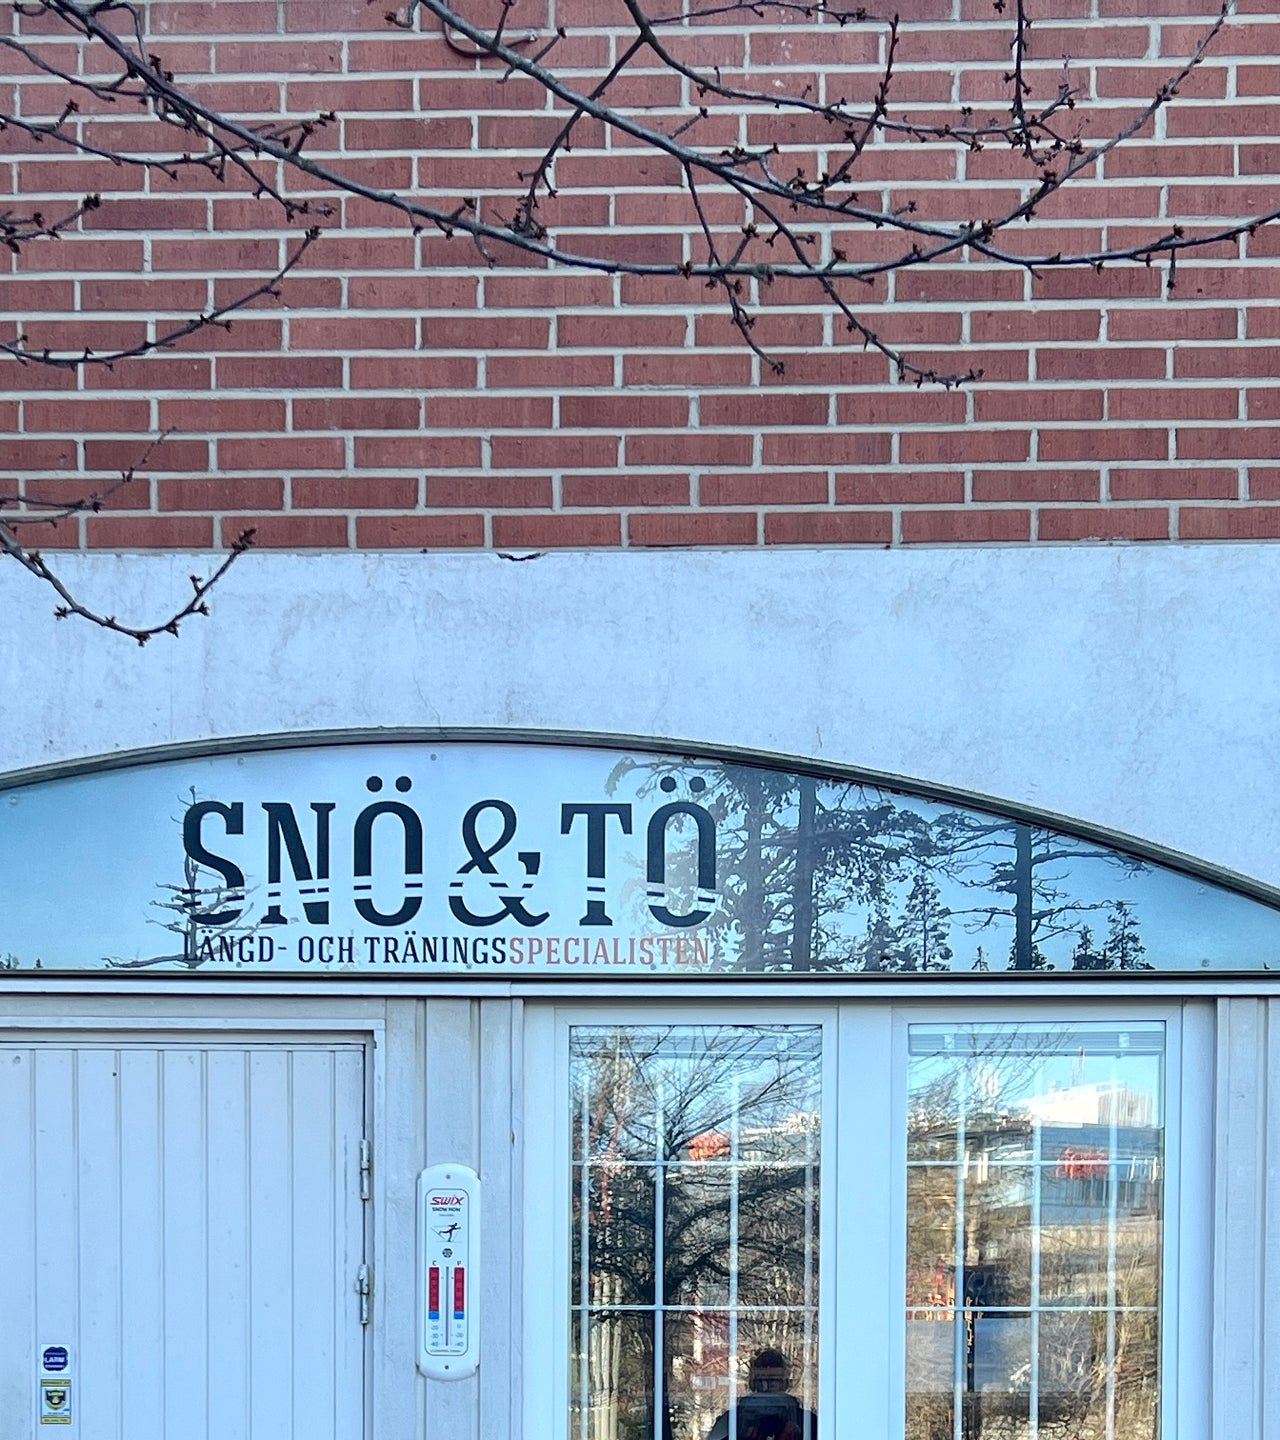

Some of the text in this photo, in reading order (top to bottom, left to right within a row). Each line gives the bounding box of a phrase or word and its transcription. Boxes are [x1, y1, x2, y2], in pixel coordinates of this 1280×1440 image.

[184, 929, 709, 965] LÄNGD- OCH TRÄNINGSSPECIALISTEN
